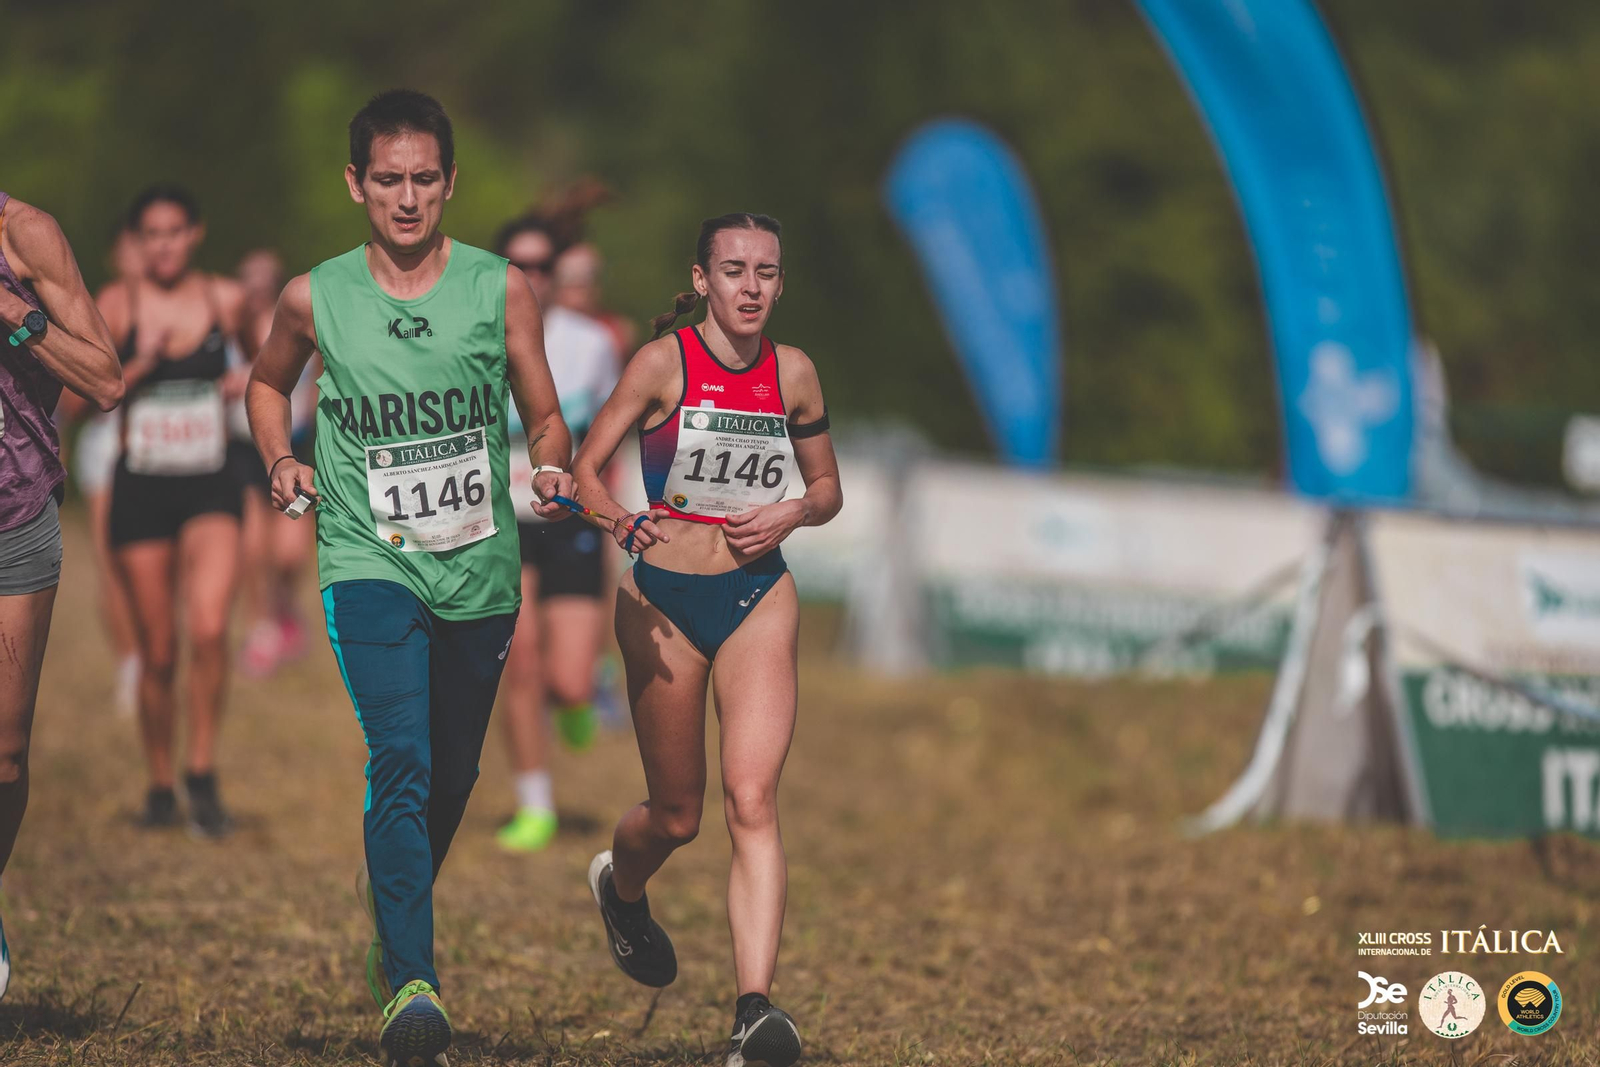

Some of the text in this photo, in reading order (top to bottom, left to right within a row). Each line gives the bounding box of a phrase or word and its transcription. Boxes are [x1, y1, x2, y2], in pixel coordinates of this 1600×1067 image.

[331, 384, 497, 440] MARISCAL
[717, 415, 769, 432] ITÁLICA
[400, 442, 458, 462] ITÁLICA
[383, 468, 407, 477] ALBERTO
[684, 448, 785, 489] 1146
[384, 469, 485, 521] 1146
